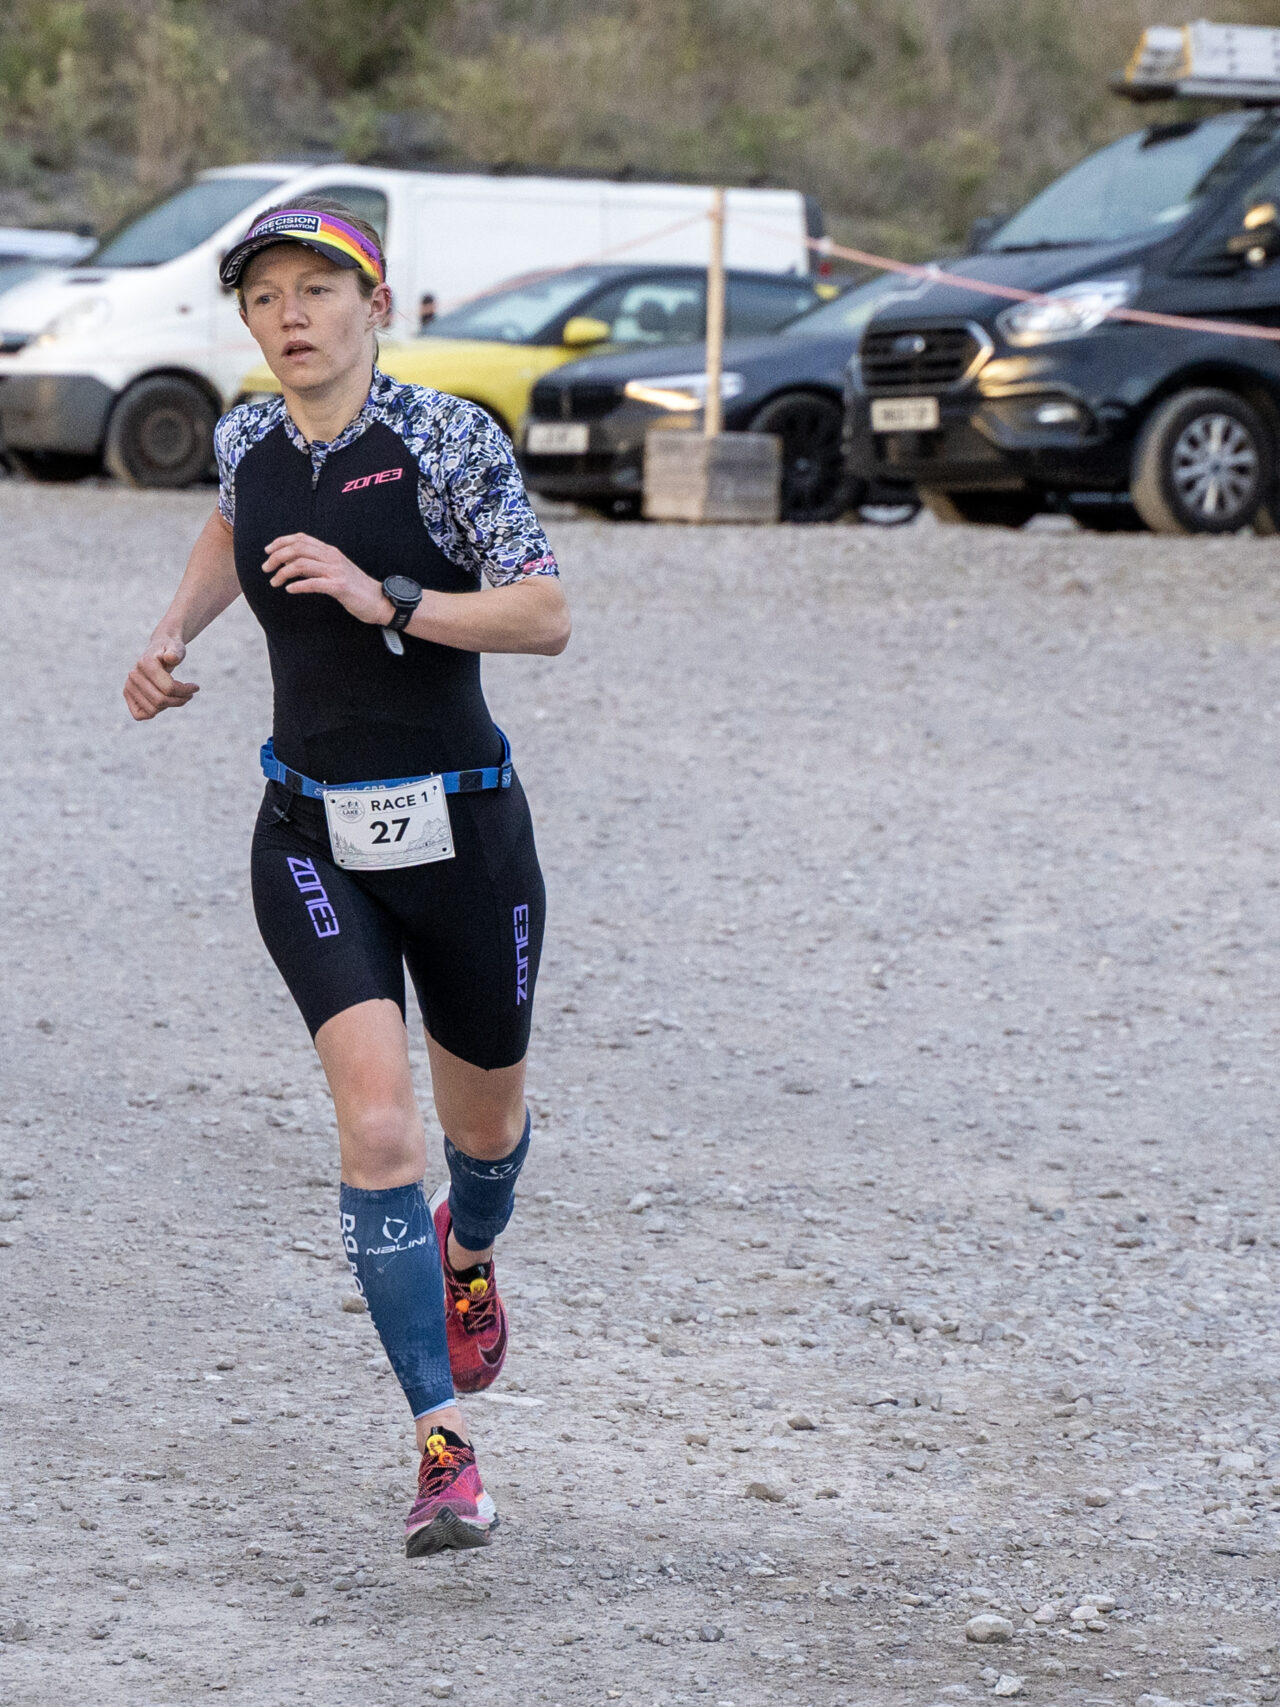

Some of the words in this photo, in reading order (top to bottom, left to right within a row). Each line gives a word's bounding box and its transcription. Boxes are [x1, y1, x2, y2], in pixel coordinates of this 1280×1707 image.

[255, 216, 317, 236] PRECISION
[275, 223, 315, 231] HYDRATION
[341, 467, 404, 494] ZONE3
[370, 794, 417, 812] RACE
[420, 791, 429, 803] 1
[369, 816, 411, 845] 27
[286, 856, 340, 939] ZONE3
[513, 903, 529, 1006] ZONE3
